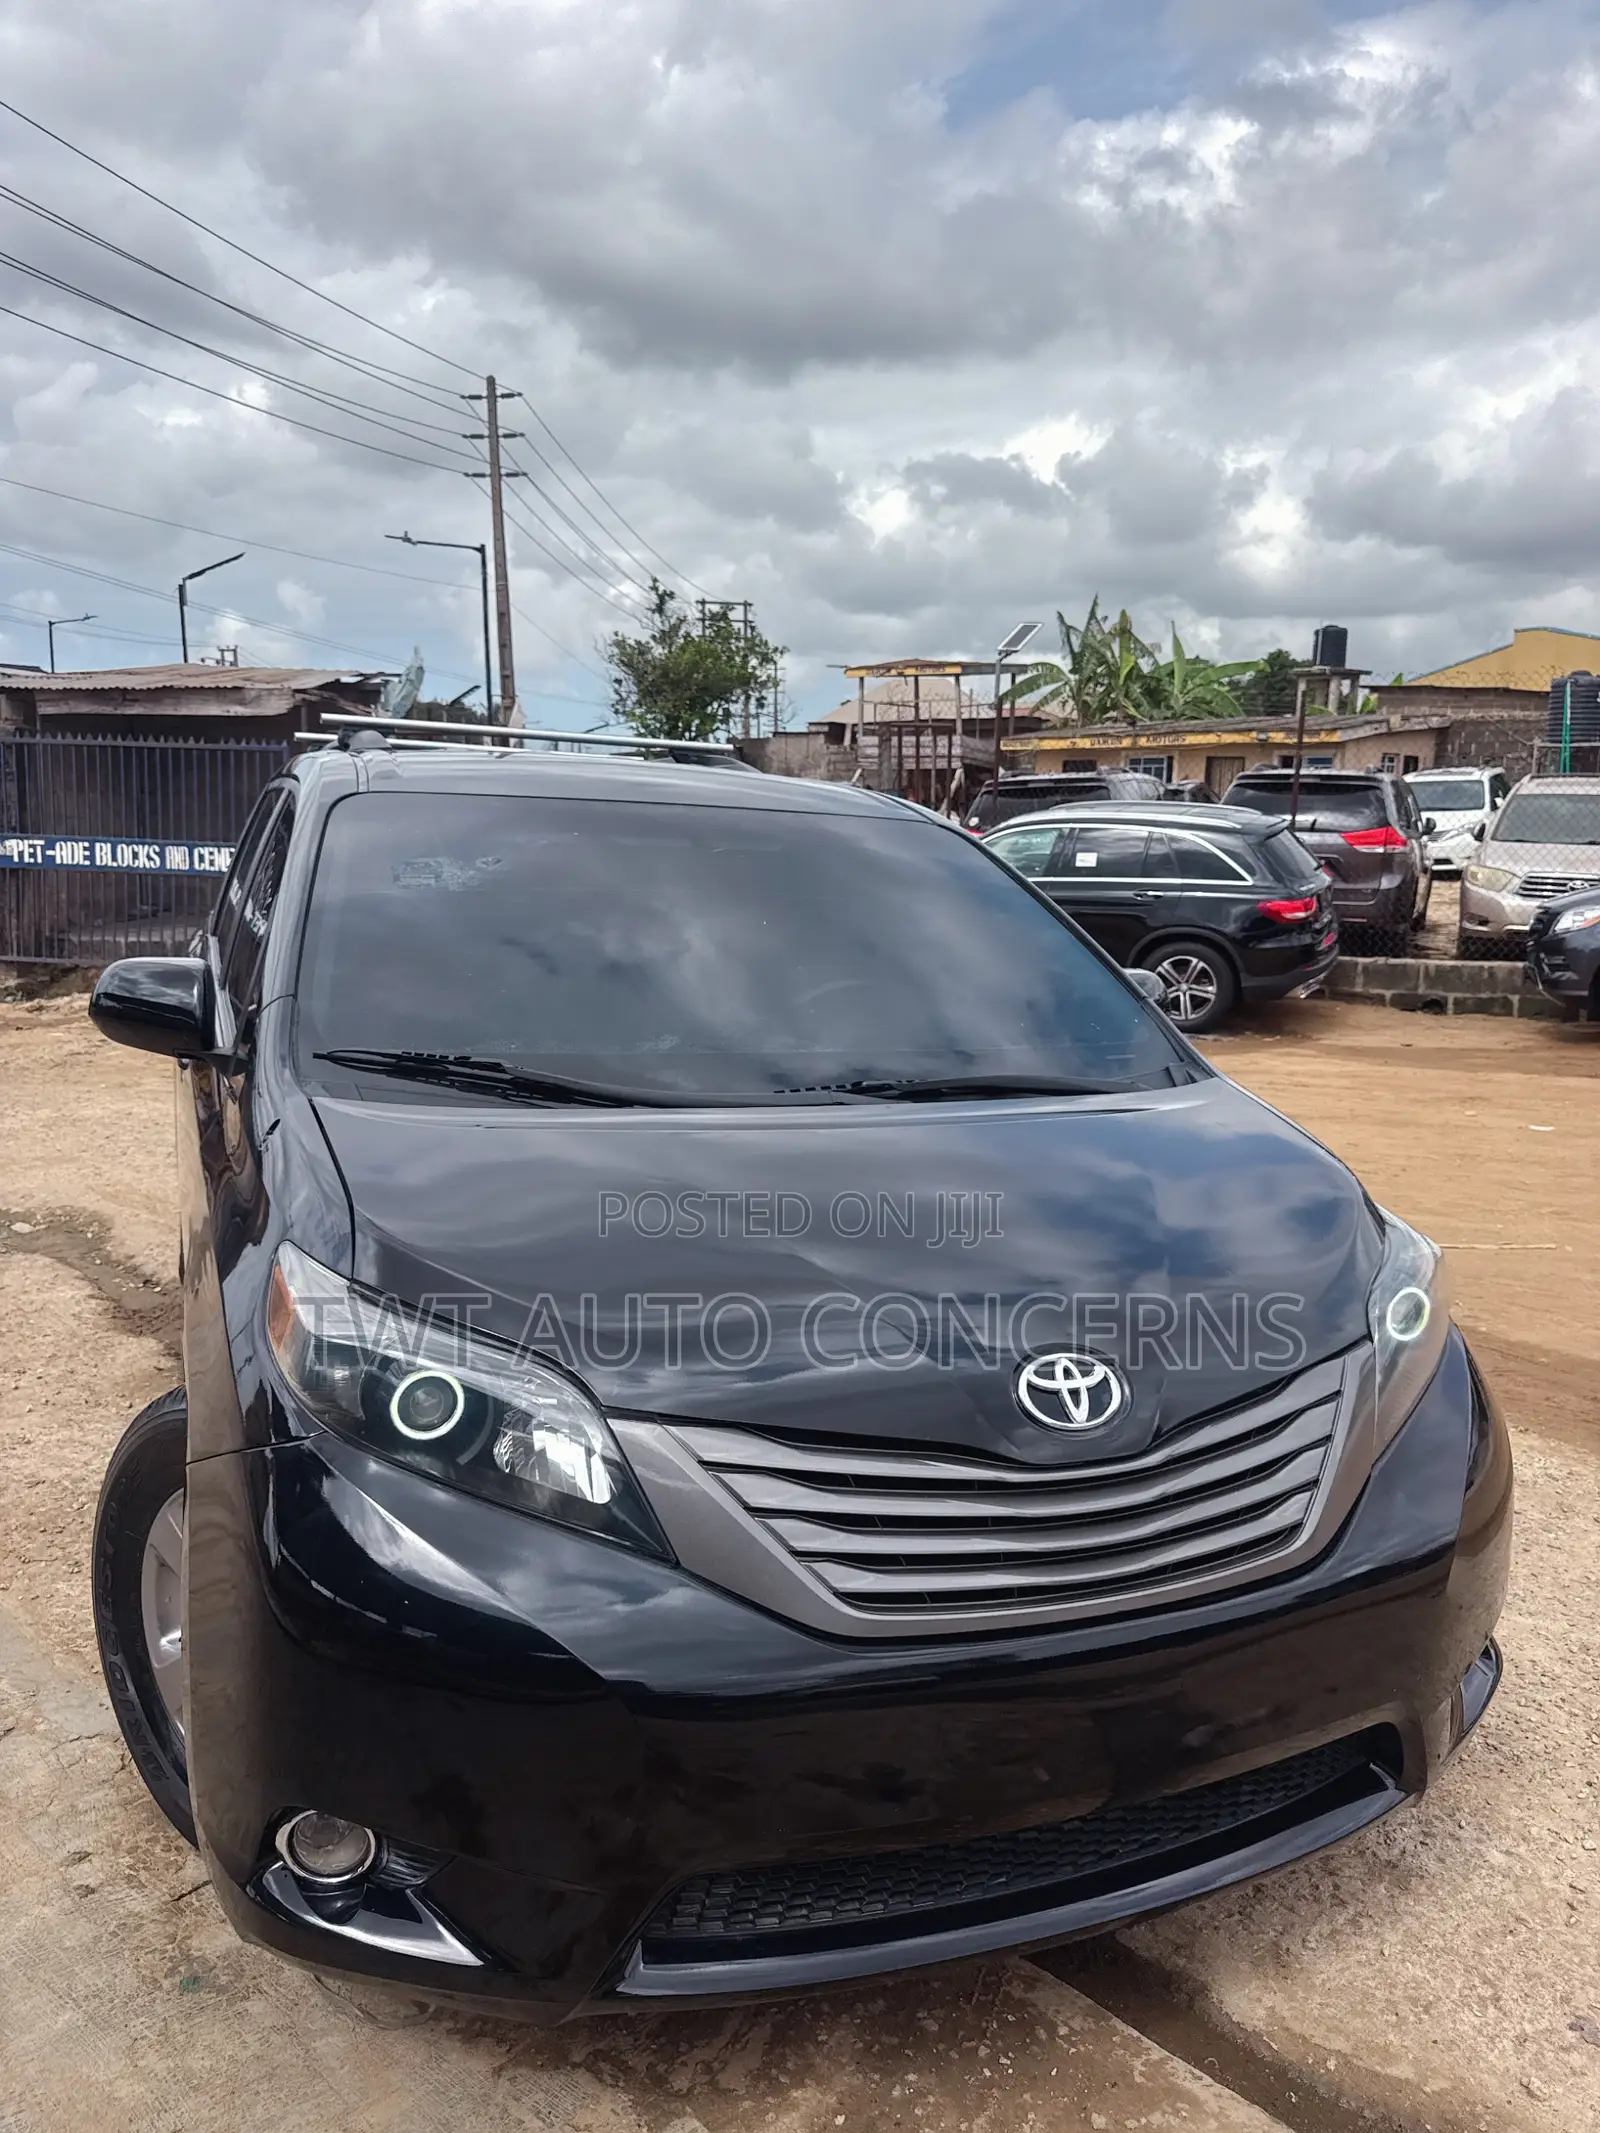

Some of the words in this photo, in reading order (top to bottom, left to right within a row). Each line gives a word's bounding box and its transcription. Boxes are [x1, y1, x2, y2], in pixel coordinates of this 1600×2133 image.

[11, 838, 90, 866] PET-ADE
[94, 842, 160, 869] BLOCKS
[165, 846, 189, 871] AND
